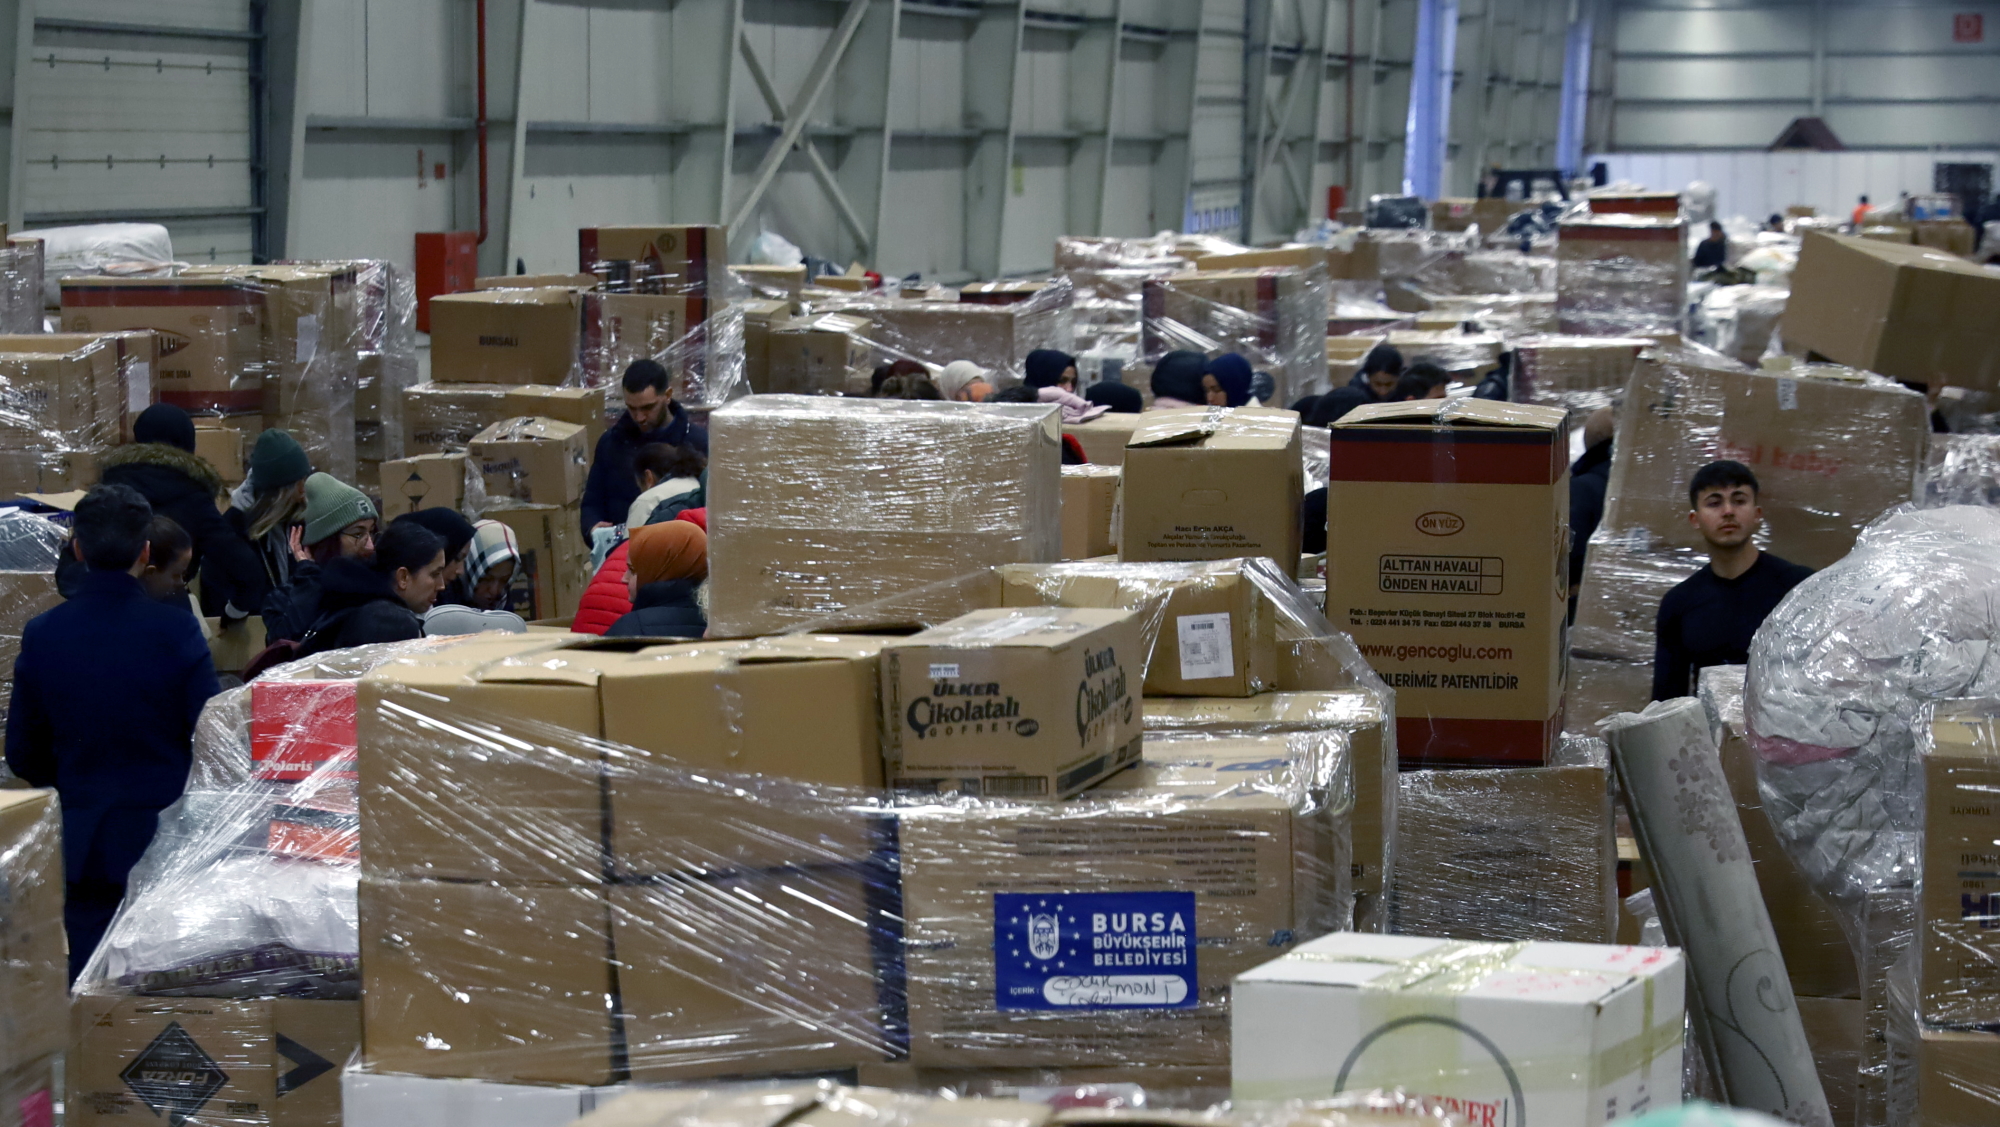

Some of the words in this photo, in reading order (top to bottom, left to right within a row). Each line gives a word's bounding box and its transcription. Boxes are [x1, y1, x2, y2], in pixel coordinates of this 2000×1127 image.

[479, 335, 518, 347] BURSALI
[1212, 525, 1234, 533] AKÇA
[1422, 517, 1436, 529] ÖN
[1439, 517, 1458, 529] YÜZ
[1383, 559, 1431, 572] ALTTAN
[1434, 560, 1479, 573] HAVALI
[1383, 576, 1427, 591] ÖNDEN
[1431, 579, 1478, 592] HAVALI
[1423, 611, 1446, 619] Sanayi
[1358, 644, 1513, 662] www.gencoglu.com
[1375, 670, 1437, 688] NLERİMİZ
[1441, 672, 1519, 689] PATENTLİDİR
[933, 679, 1000, 697] ÜLKER
[907, 696, 1020, 740] Çikolatalı
[930, 722, 1013, 738] GOFRET
[258, 760, 313, 771] Polaris
[1949, 806, 1990, 816] TÜRKİYE
[1962, 881, 1986, 889] 1980
[1092, 912, 1186, 933] BURSA
[1093, 932, 1186, 950] BÜYÜKŞEHİR
[1094, 949, 1187, 966] BELEDİYESİ
[142, 1070, 210, 1085] FORZA
